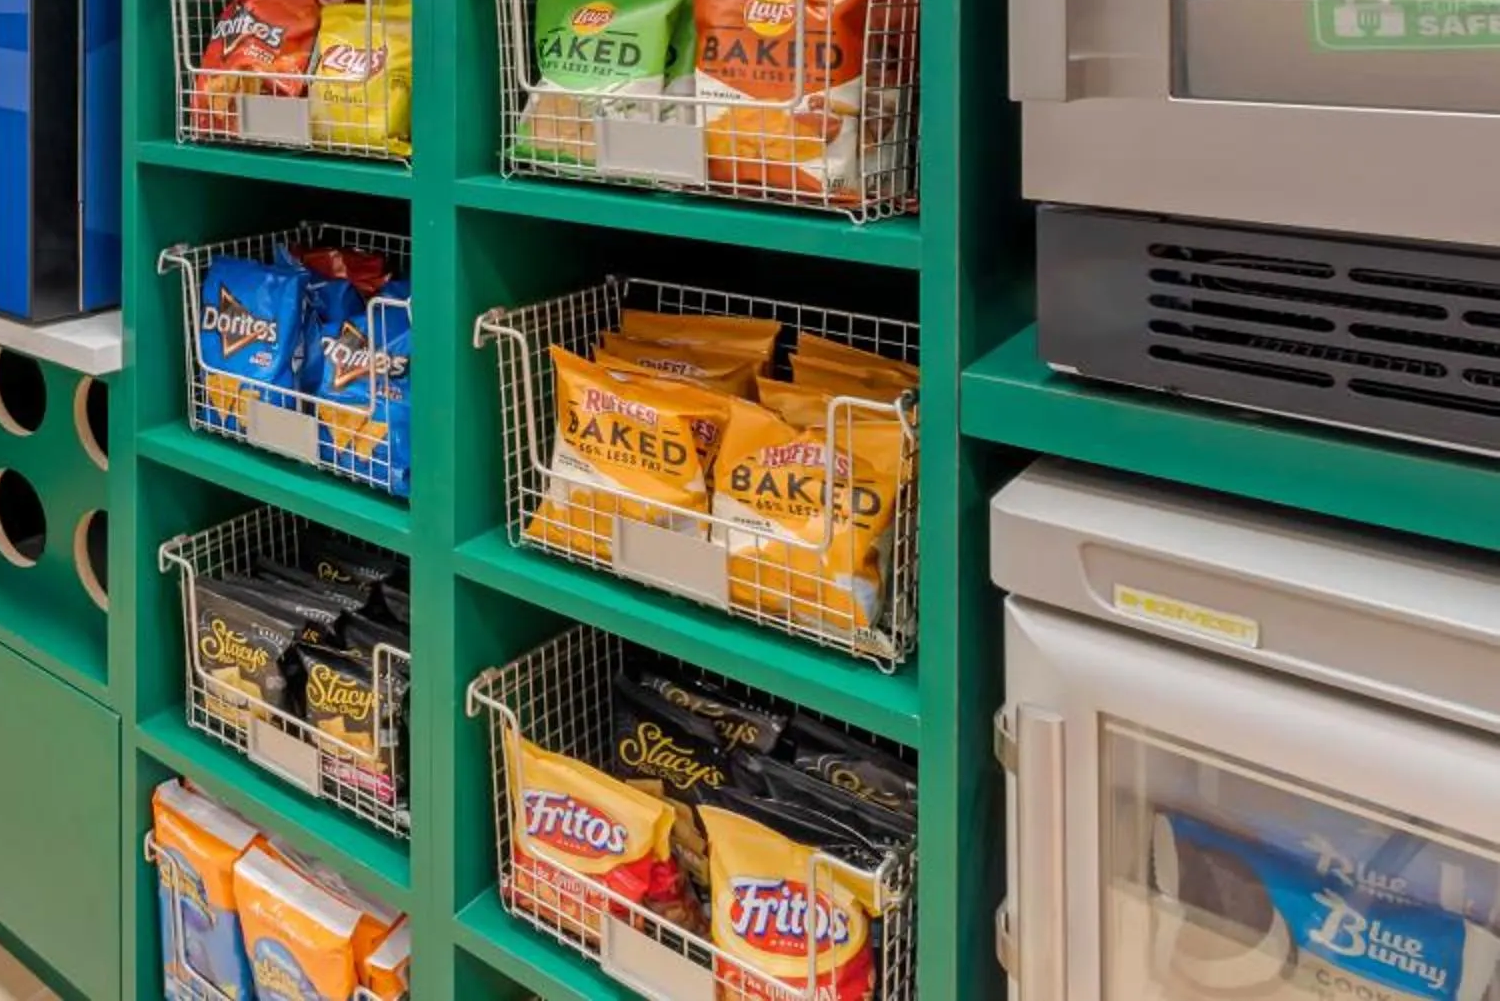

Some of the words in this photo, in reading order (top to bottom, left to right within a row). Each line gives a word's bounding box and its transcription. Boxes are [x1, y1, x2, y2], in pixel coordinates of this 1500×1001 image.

[702, 35, 845, 71] BAKED
[203, 306, 277, 343] Doritos
[585, 388, 657, 426] RUFFLES
[567, 410, 688, 467] BAKED
[607, 450, 637, 466] LESS
[763, 443, 850, 478] RUFFLS
[731, 464, 881, 517] BAKED
[788, 503, 820, 518] LESS
[201, 619, 269, 673] Stacy's
[306, 664, 382, 721] Stacy
[619, 721, 726, 791] Stacy's
[524, 789, 629, 855] Fritos
[730, 876, 850, 945] Fritos
